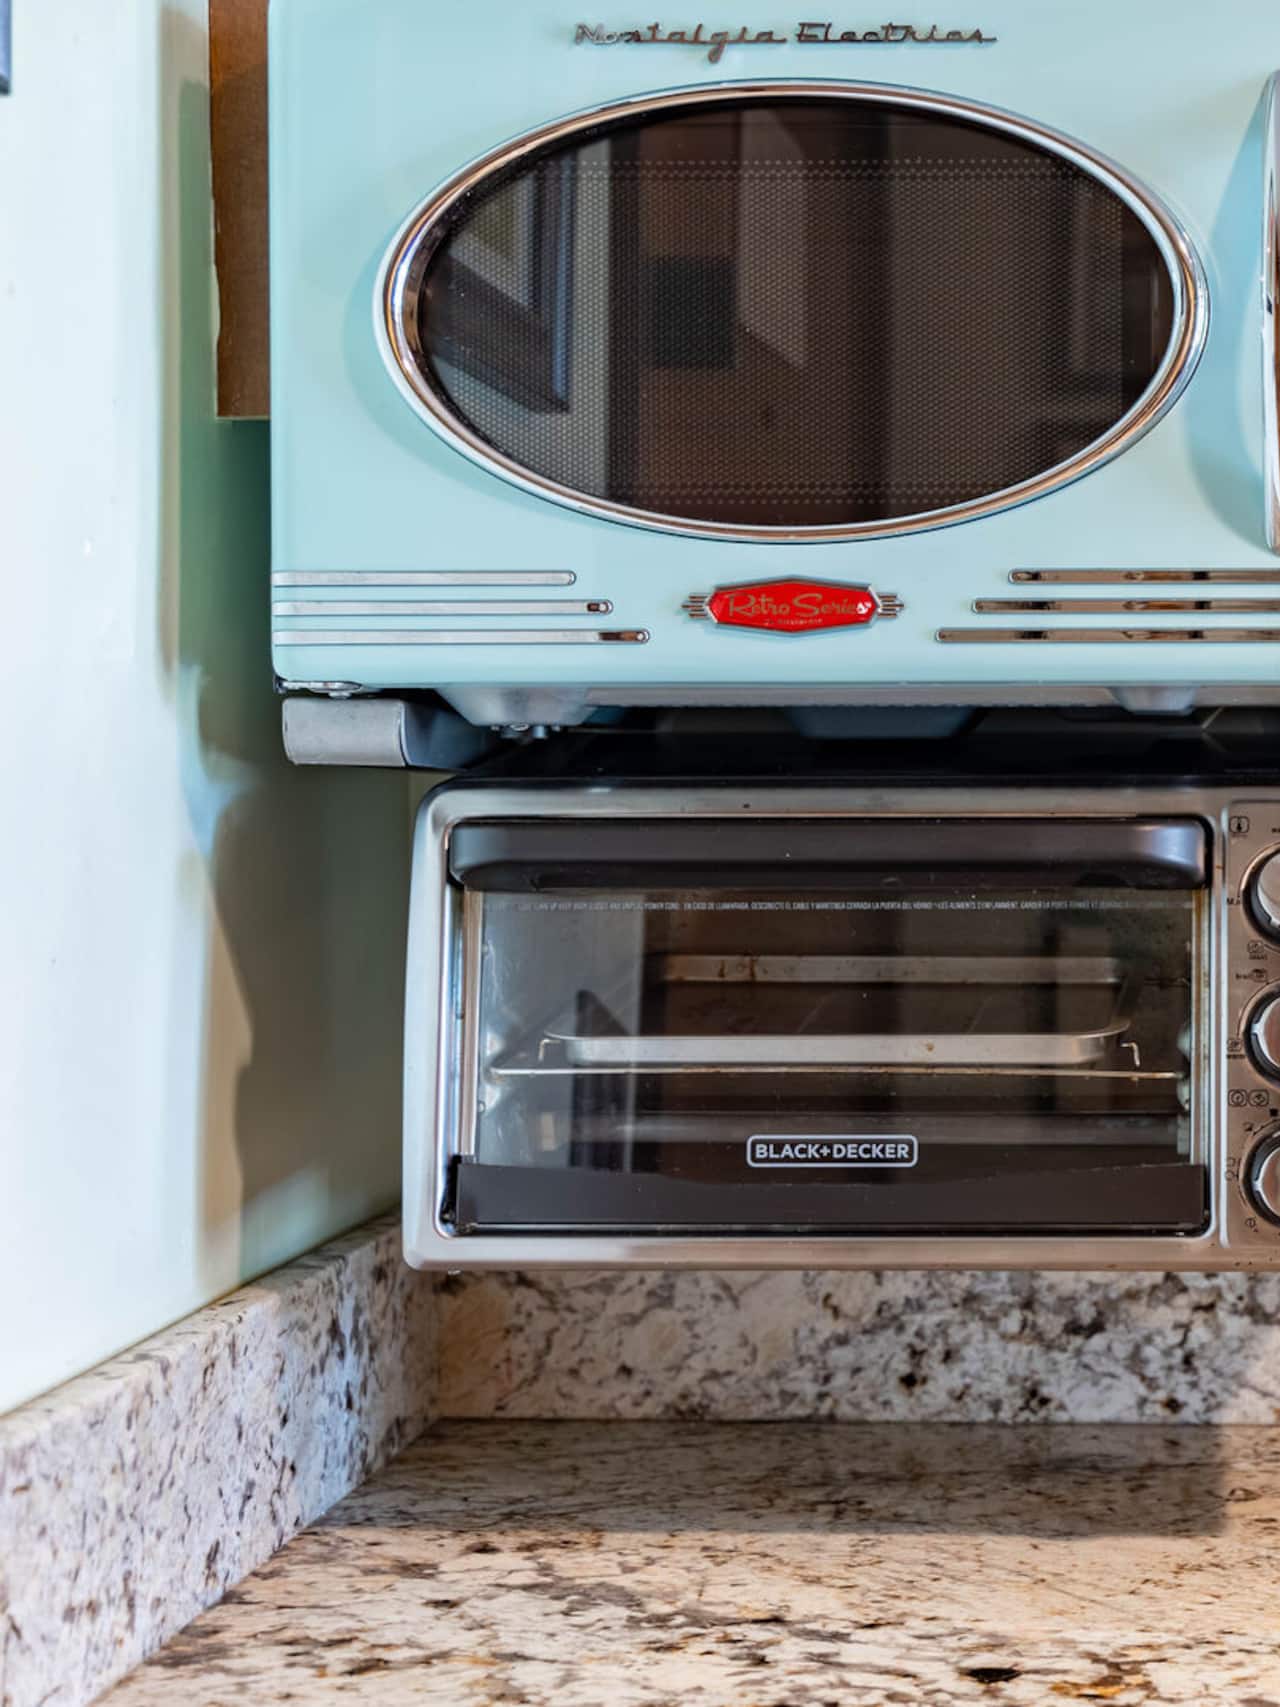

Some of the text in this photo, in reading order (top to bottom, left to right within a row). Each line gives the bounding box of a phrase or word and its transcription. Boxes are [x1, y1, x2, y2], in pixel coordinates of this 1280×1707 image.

[574, 22, 997, 64] Nostalgia Electrics
[727, 592, 790, 617] Retro
[755, 1143, 909, 1159] BLACK+DECKER
